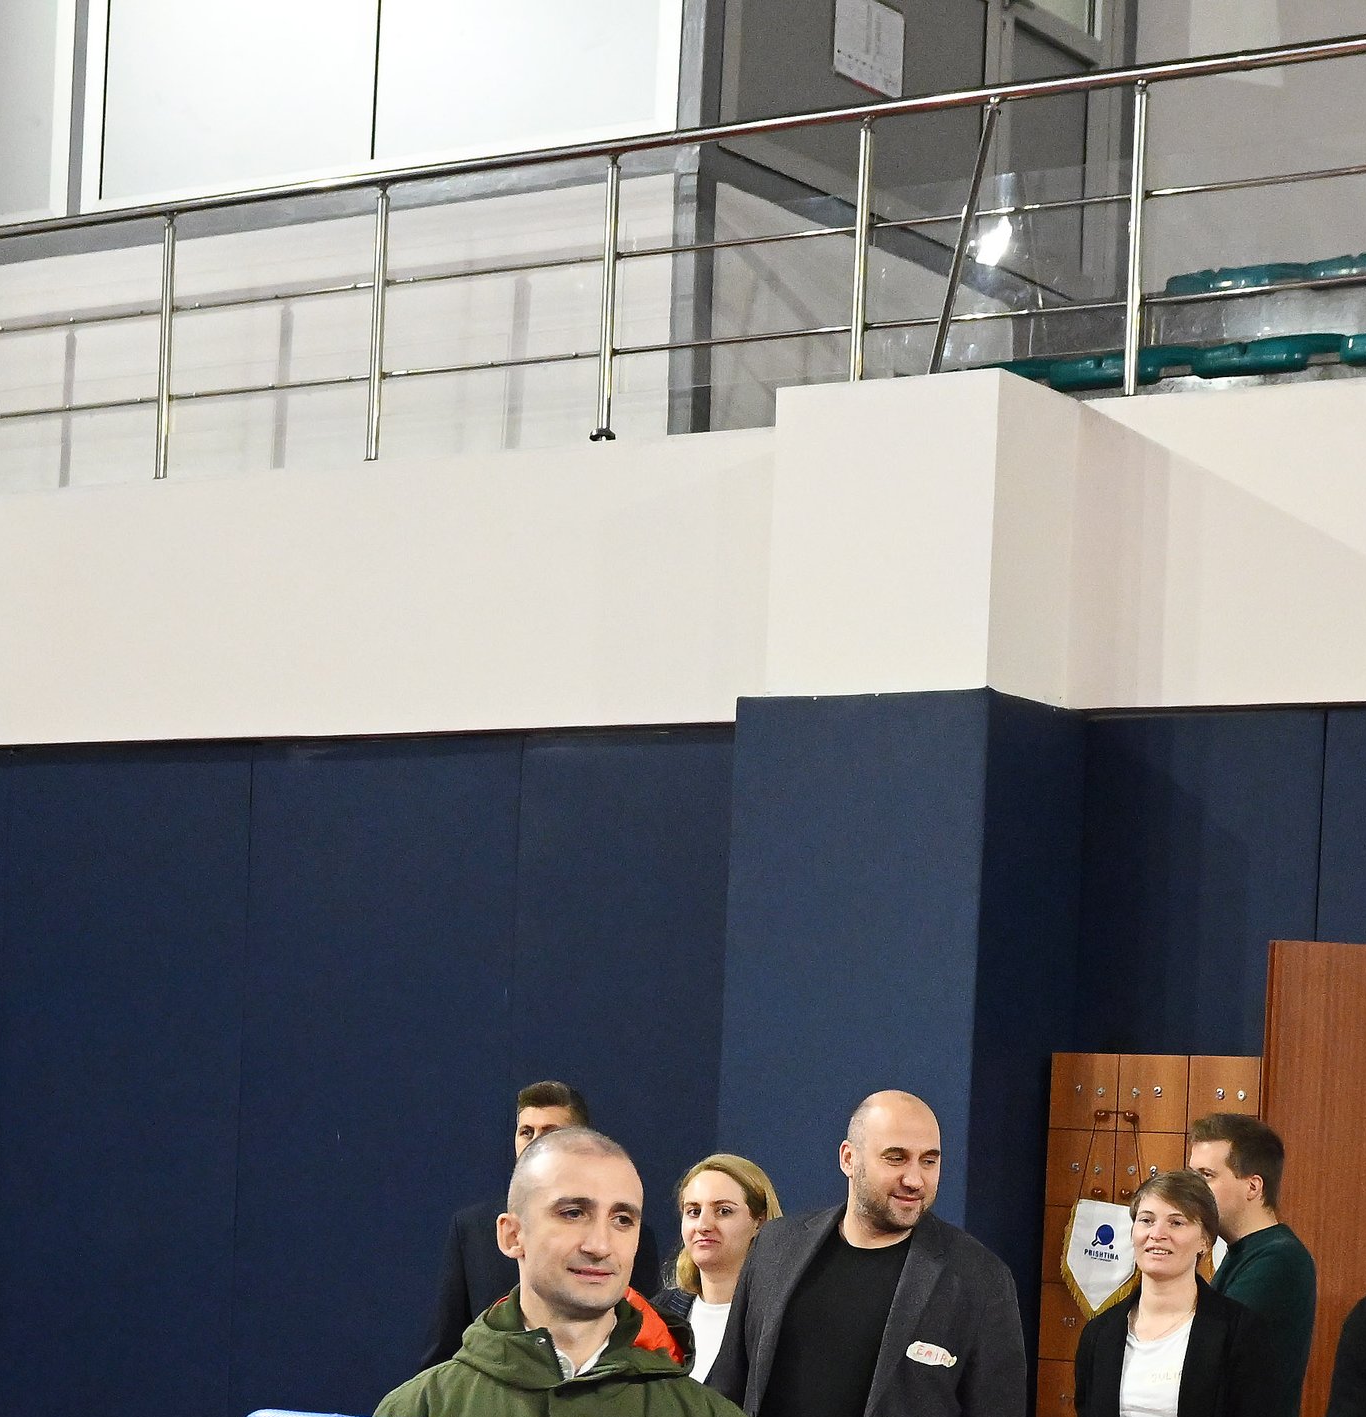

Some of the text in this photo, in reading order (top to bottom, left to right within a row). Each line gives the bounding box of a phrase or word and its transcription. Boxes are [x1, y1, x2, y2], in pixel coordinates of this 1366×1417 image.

[1153, 1086, 1163, 1098] 2
[1216, 1087, 1226, 1100] 3
[1083, 1248, 1120, 1261] PRISHTINA
